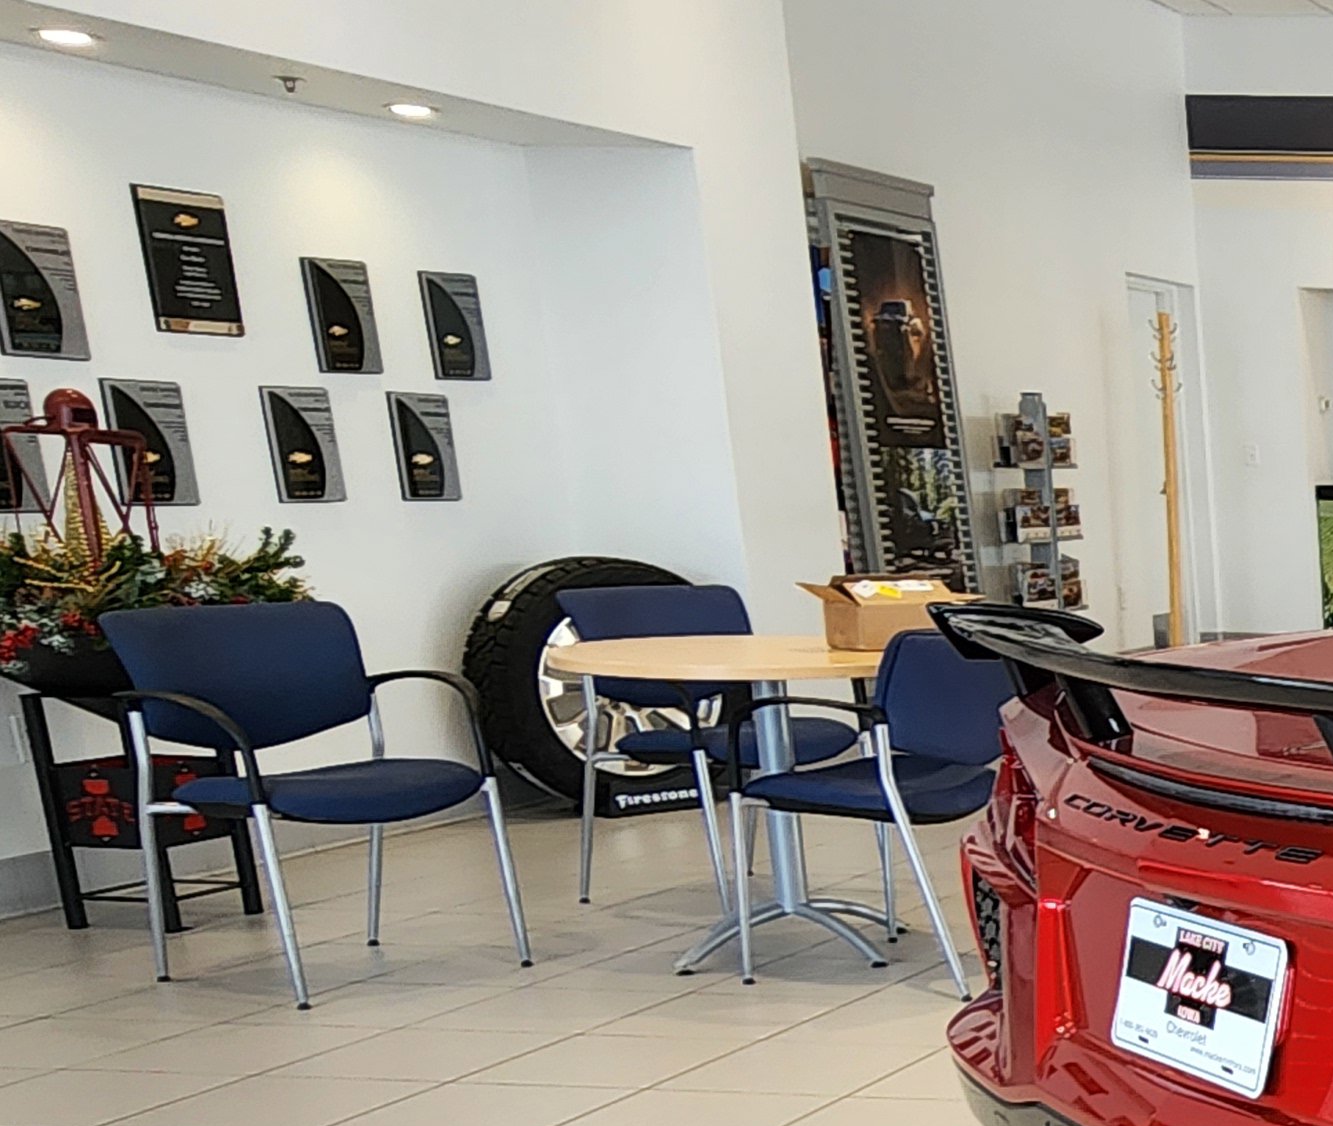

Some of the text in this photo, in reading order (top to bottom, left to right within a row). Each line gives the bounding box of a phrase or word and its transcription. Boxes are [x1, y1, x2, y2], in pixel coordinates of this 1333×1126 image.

[614, 788, 699, 810] Firestone
[1064, 793, 1324, 865] CORVETTE
[1179, 930, 1226, 955] LAKE CITY
[1156, 948, 1232, 1008] Macke
[1166, 1020, 1208, 1046] Chevrolet
